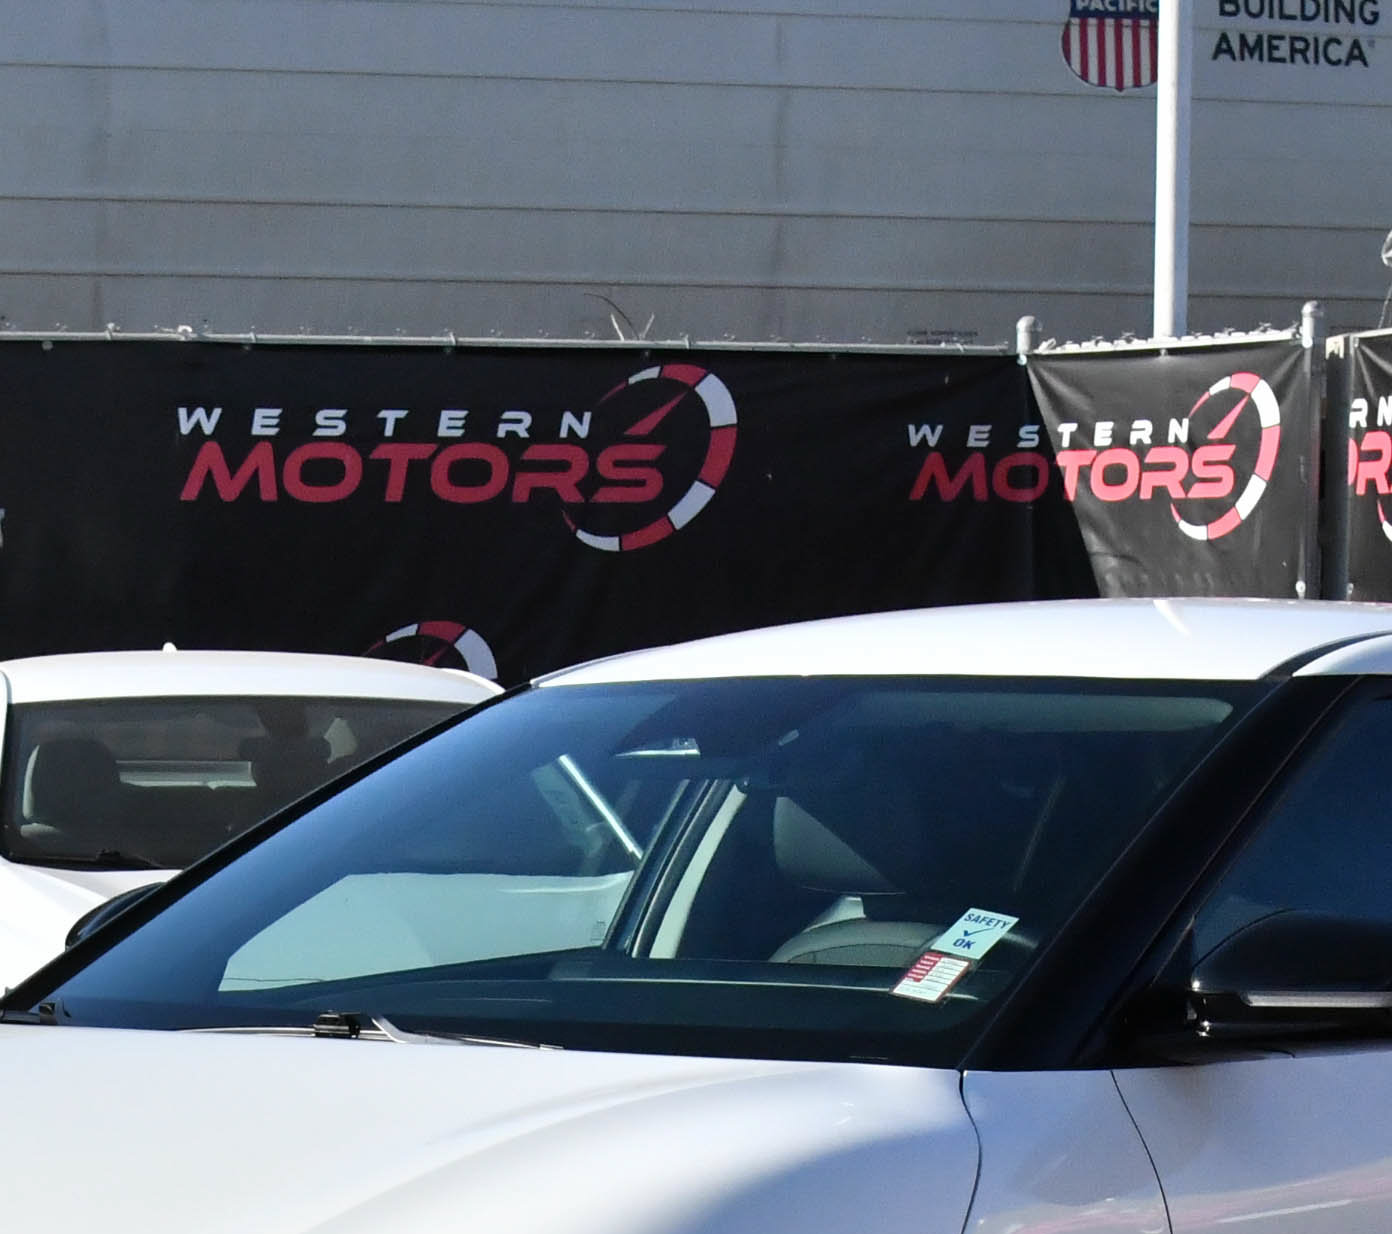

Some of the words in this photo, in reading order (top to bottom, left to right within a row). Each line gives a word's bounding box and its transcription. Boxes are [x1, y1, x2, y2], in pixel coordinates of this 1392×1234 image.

[1219, 0, 1380, 25] BUILDING
[1212, 31, 1369, 68] AMERICA
[178, 408, 591, 438] WESTERN
[908, 418, 1190, 448] WESTERN
[181, 441, 665, 503] MOTORS
[911, 443, 1236, 502] MOTORS
[963, 912, 1011, 930] SAFETY
[952, 937, 975, 951] OK
